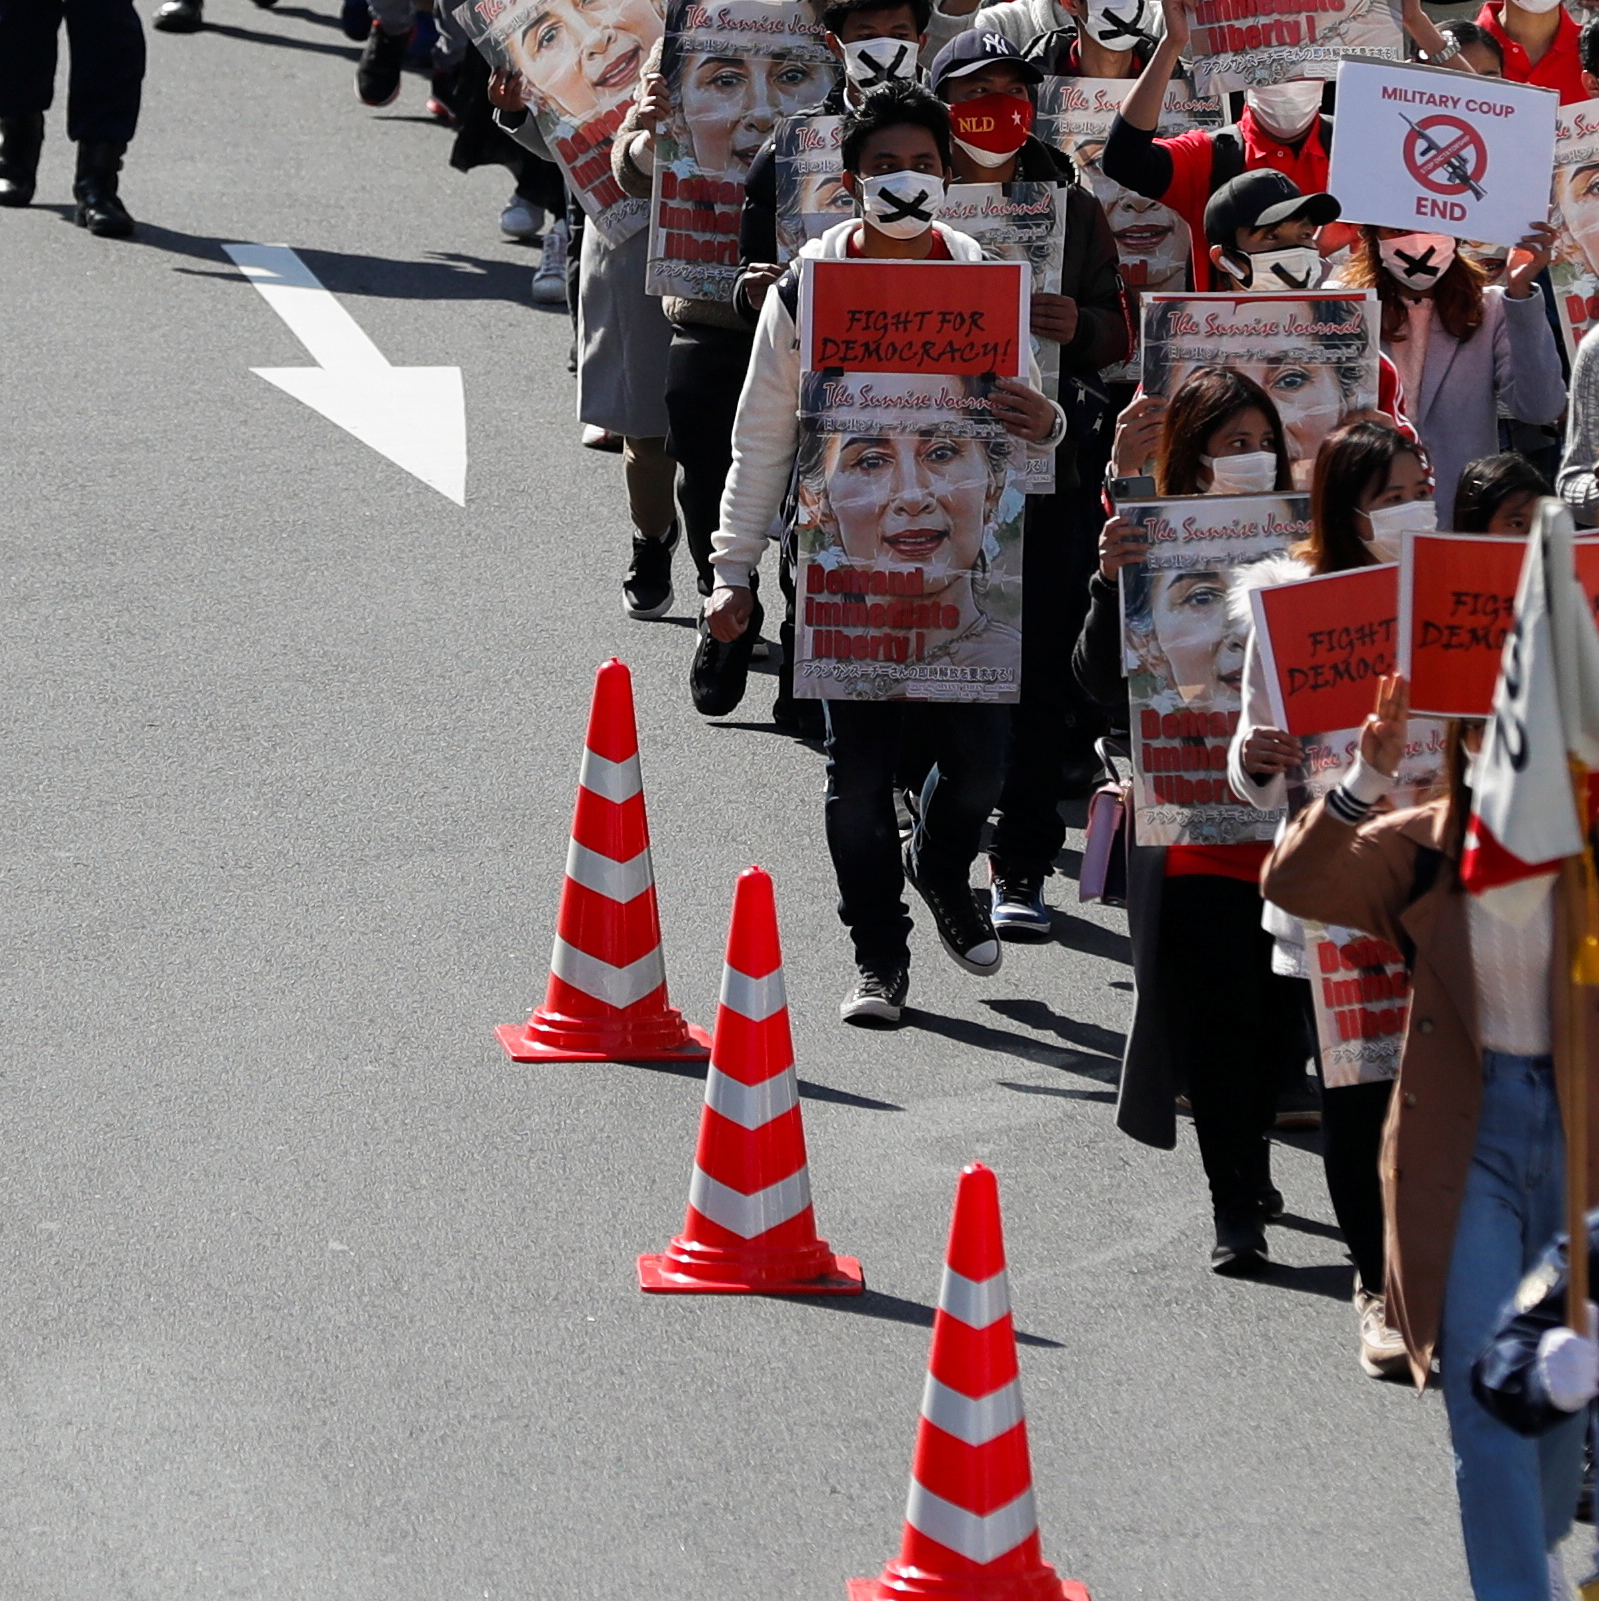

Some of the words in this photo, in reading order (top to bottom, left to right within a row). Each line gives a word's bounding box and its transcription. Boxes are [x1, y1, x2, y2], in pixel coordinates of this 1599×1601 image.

[685, 4, 712, 29] The
[716, 8, 783, 33] Sunrise
[1207, 18, 1303, 55] liberty
[1060, 86, 1089, 110] The
[1164, 92, 1221, 112] Journal
[1381, 85, 1462, 110] MILITARY
[1465, 98, 1516, 118] COUP
[796, 126, 824, 149] The
[959, 116, 995, 133] NLD
[979, 193, 1051, 218] Journal
[1415, 194, 1468, 223] END
[846, 309, 934, 340] FIGHT
[936, 309, 986, 338] FOR
[1167, 311, 1199, 335] The
[1203, 312, 1278, 337] Sunrise
[1282, 312, 1363, 336] Journal
[817, 337, 1012, 378] DEMOCRACY!
[822, 381, 854, 408] The
[858, 384, 931, 410] Sunrise
[1143, 516, 1176, 543] The
[1181, 516, 1258, 543] Sunrise
[807, 564, 925, 596] Demand
[812, 629, 910, 663] liberty
[1287, 653, 1394, 697] DEMOC
